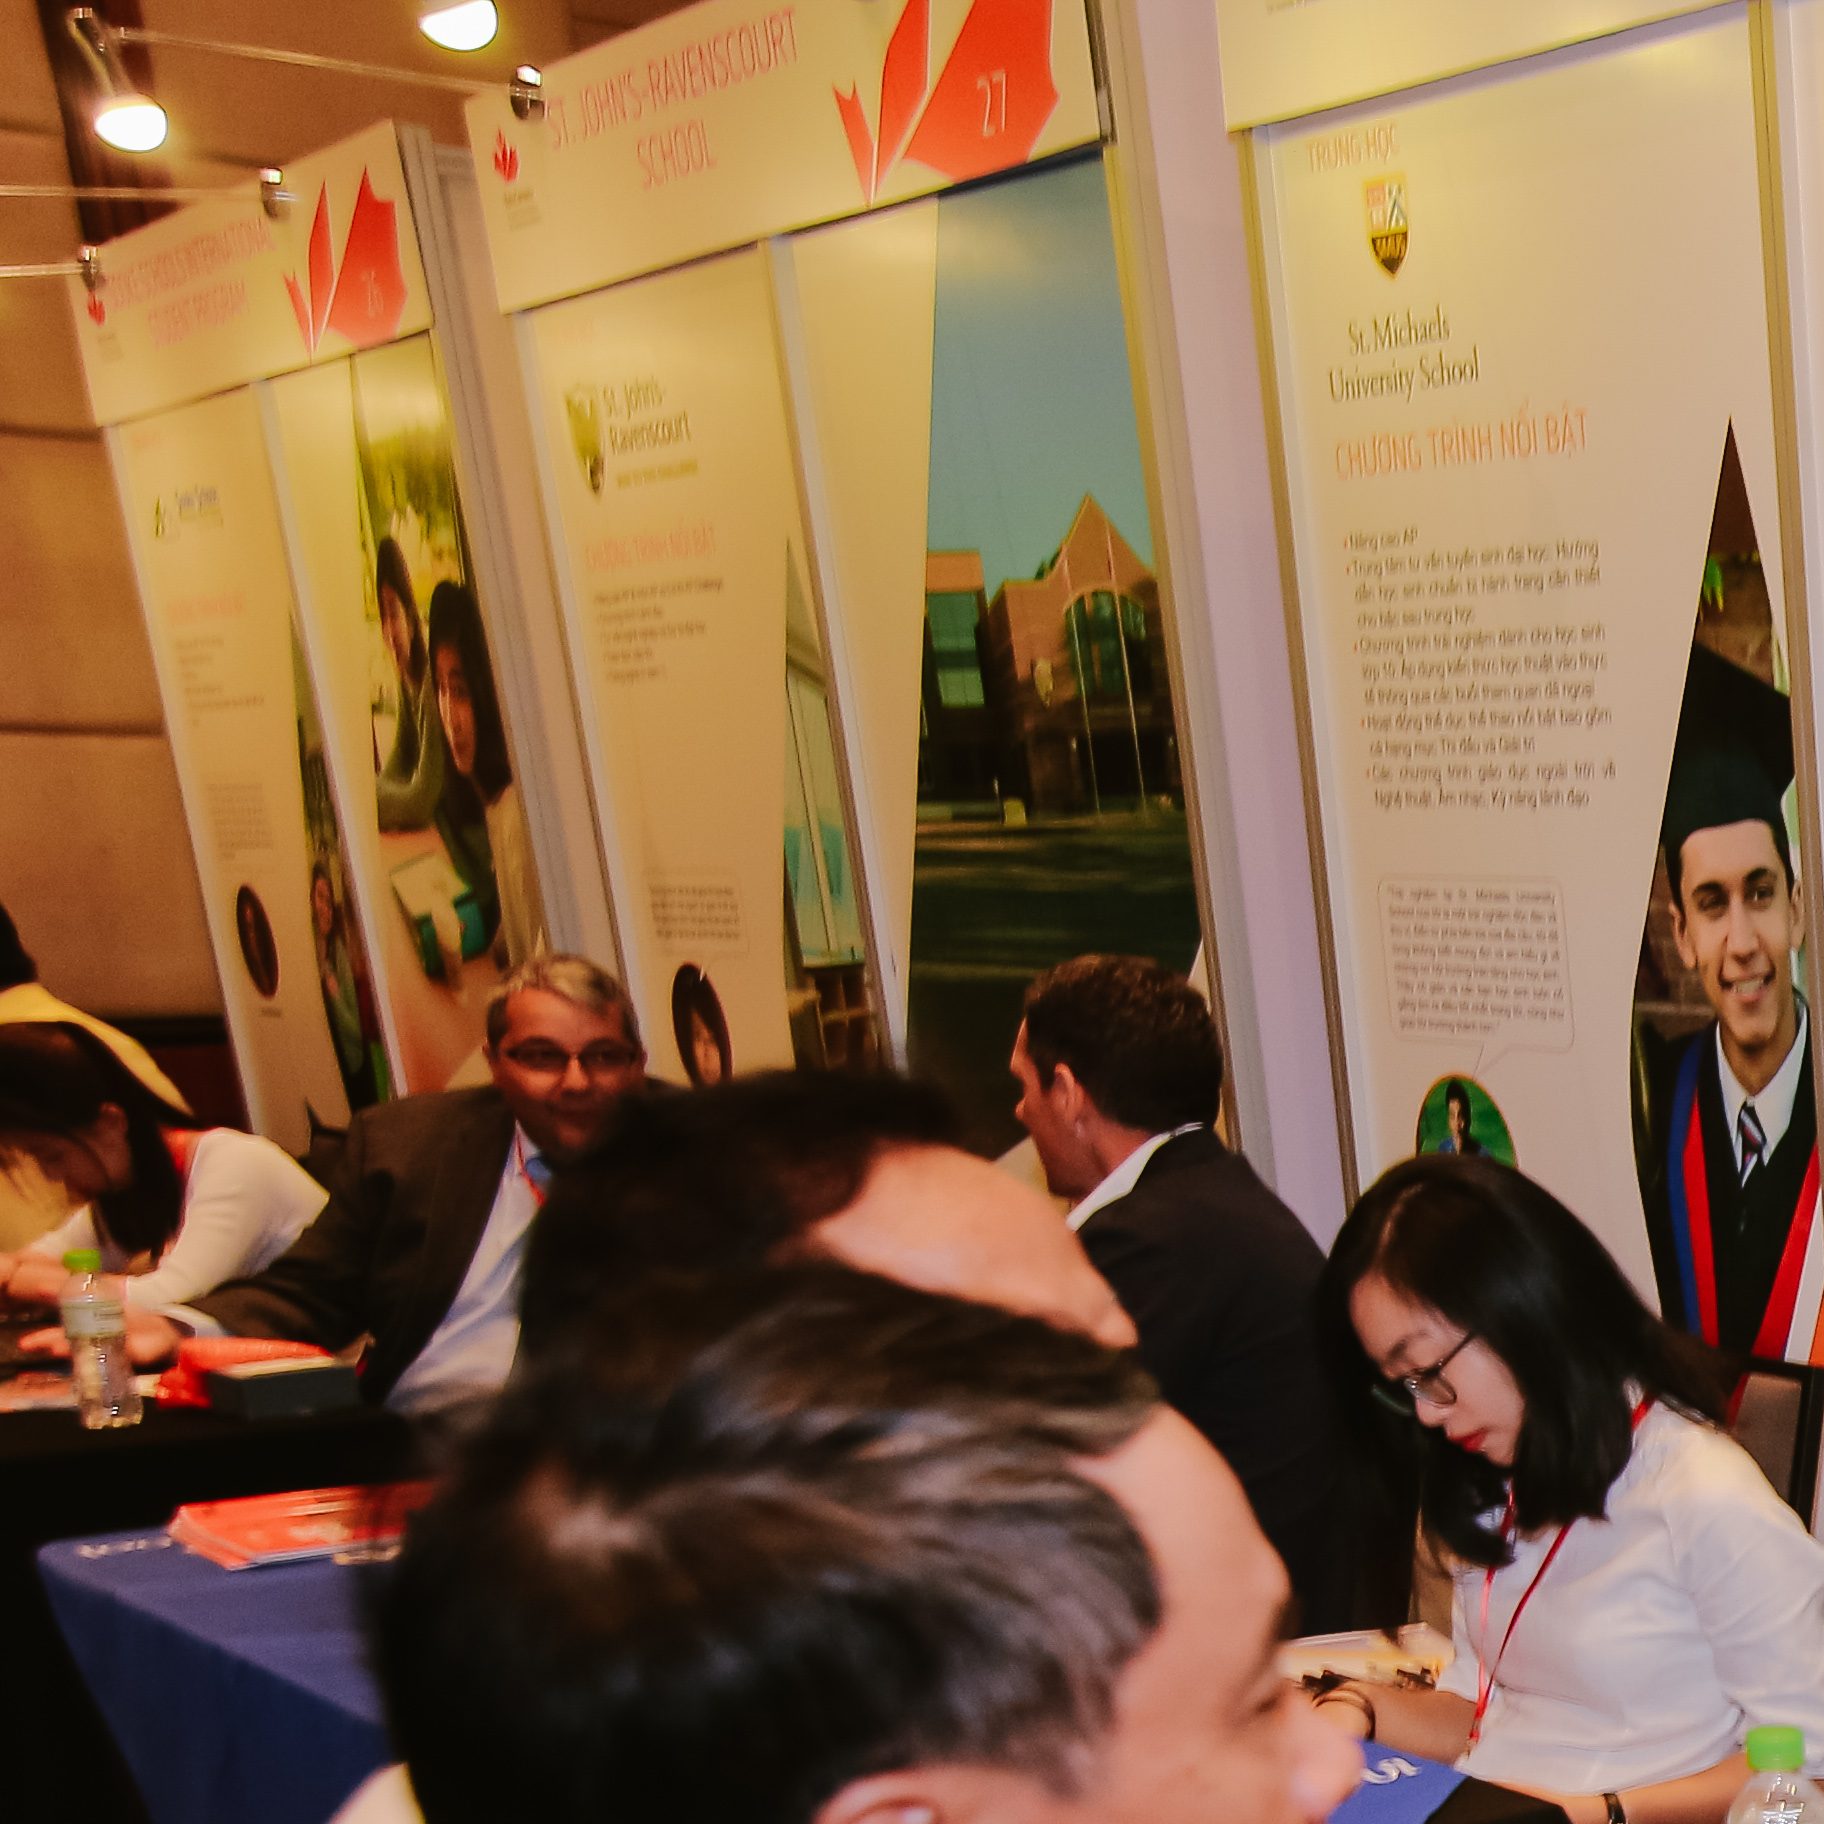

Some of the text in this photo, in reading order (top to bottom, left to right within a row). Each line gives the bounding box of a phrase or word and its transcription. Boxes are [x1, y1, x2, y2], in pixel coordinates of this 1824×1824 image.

[976, 69, 1007, 138] 27
[637, 118, 718, 190] SCHOOL
[1348, 302, 1452, 356] St. Michaels
[1329, 343, 1480, 404] University School
[608, 408, 691, 455] Ravenscourt
[1336, 398, 1587, 481] CHƯƠNG TRÌNH NỔI BẬT
